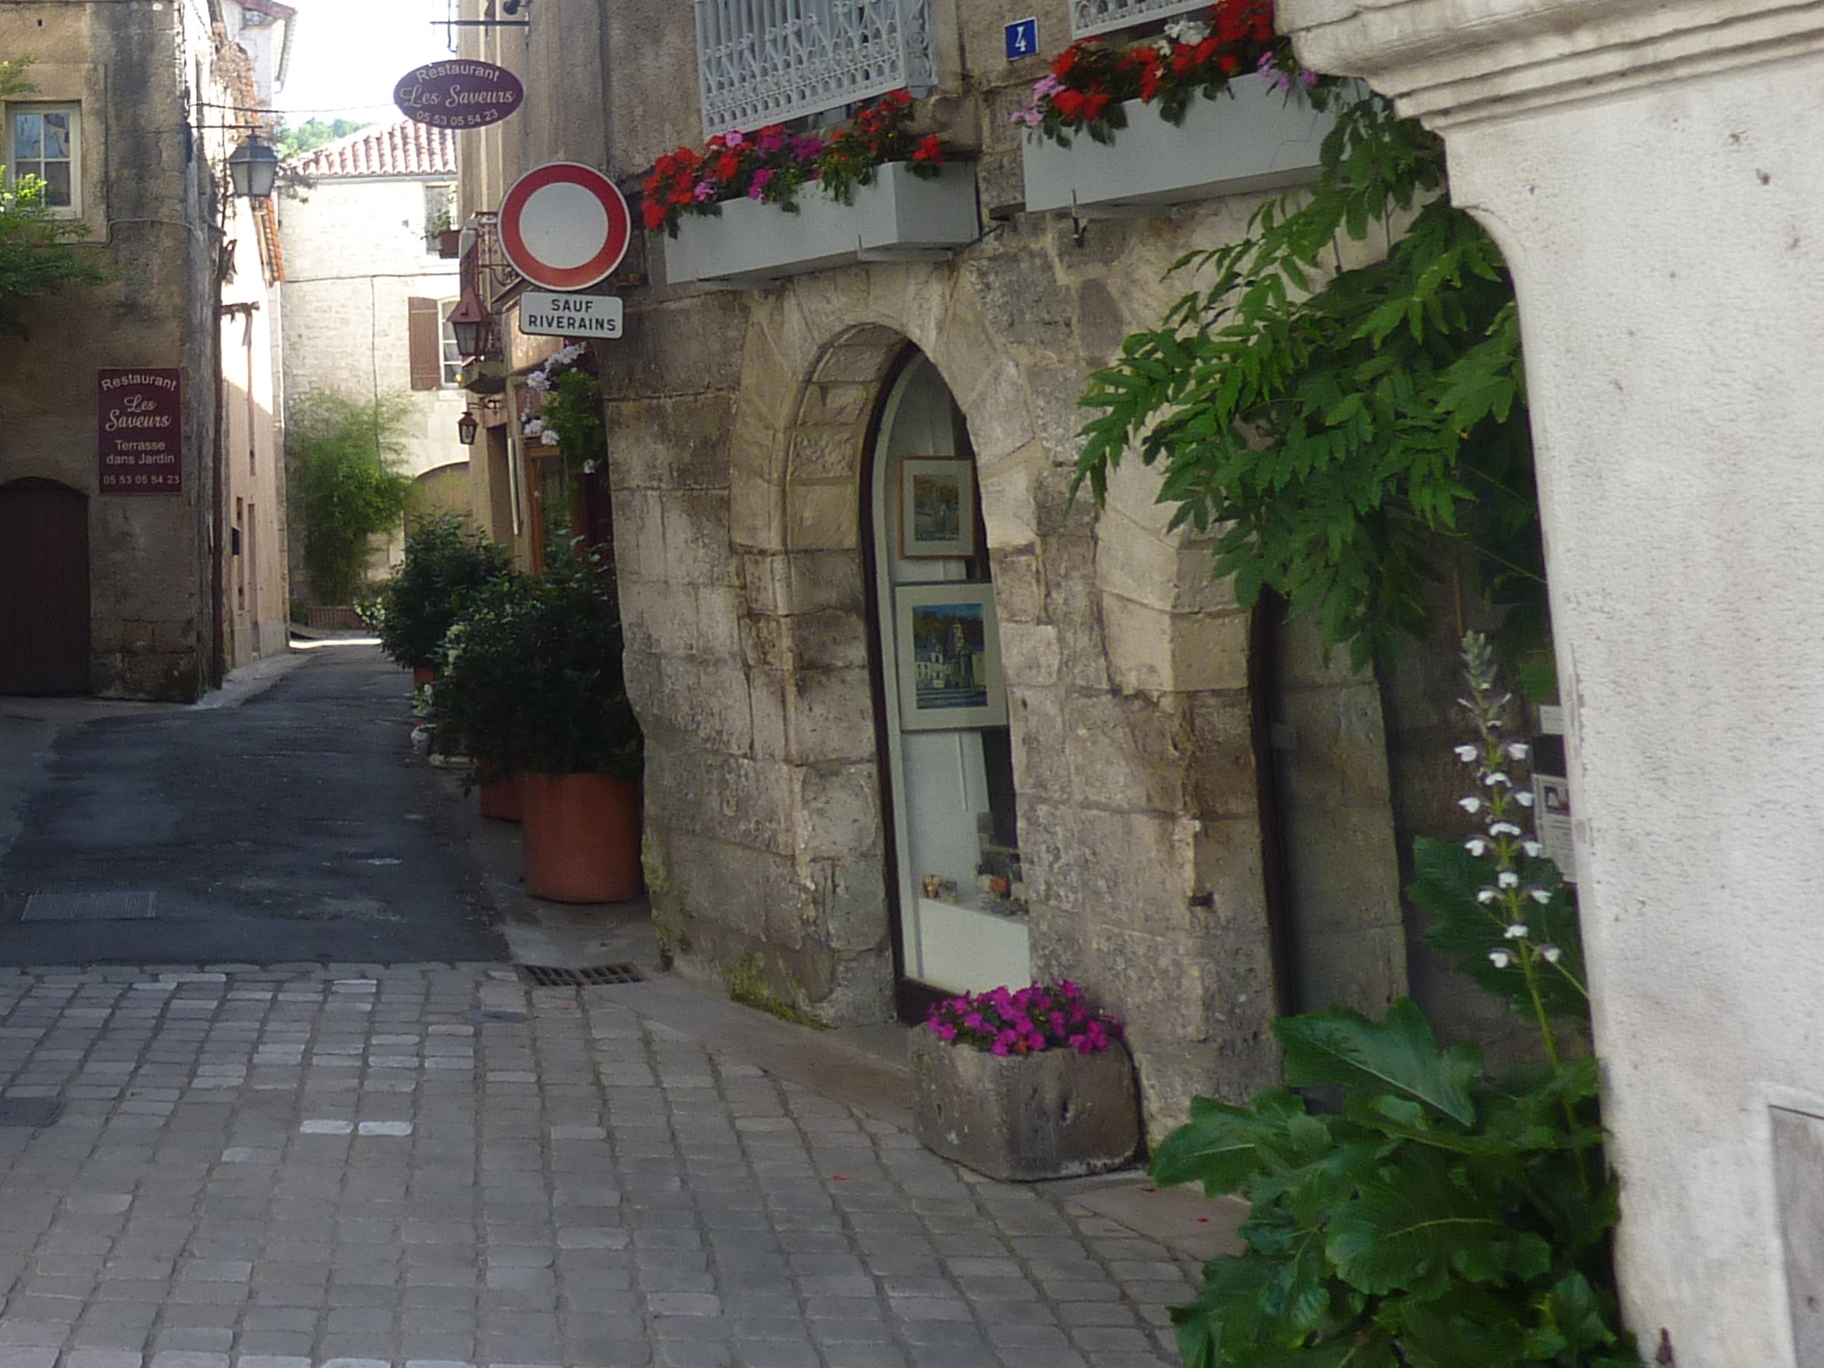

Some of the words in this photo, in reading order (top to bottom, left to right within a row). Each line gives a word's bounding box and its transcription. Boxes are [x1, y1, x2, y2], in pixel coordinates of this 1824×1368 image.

[1014, 25, 1027, 52] 4
[416, 63, 500, 82] Restaurant
[398, 84, 441, 108] Les
[444, 84, 516, 108] Saveurs
[416, 110, 431, 122] 05
[433, 115, 447, 126] 53
[450, 116, 465, 126] 05
[467, 113, 481, 125] 54
[484, 109, 499, 121] 23
[551, 298, 594, 314] SAUF
[528, 314, 617, 332] RIVERAINS
[101, 374, 177, 391] Restaurant
[123, 393, 158, 413] Les
[104, 409, 173, 431] Saveurs
[114, 439, 166, 451] Terrasse
[106, 453, 135, 465] dans
[138, 453, 175, 464] Jardin
[103, 475, 116, 485] 05
[119, 475, 132, 485] 53
[135, 475, 148, 484] 05
[151, 475, 163, 484] 54
[167, 475, 179, 484] 23
